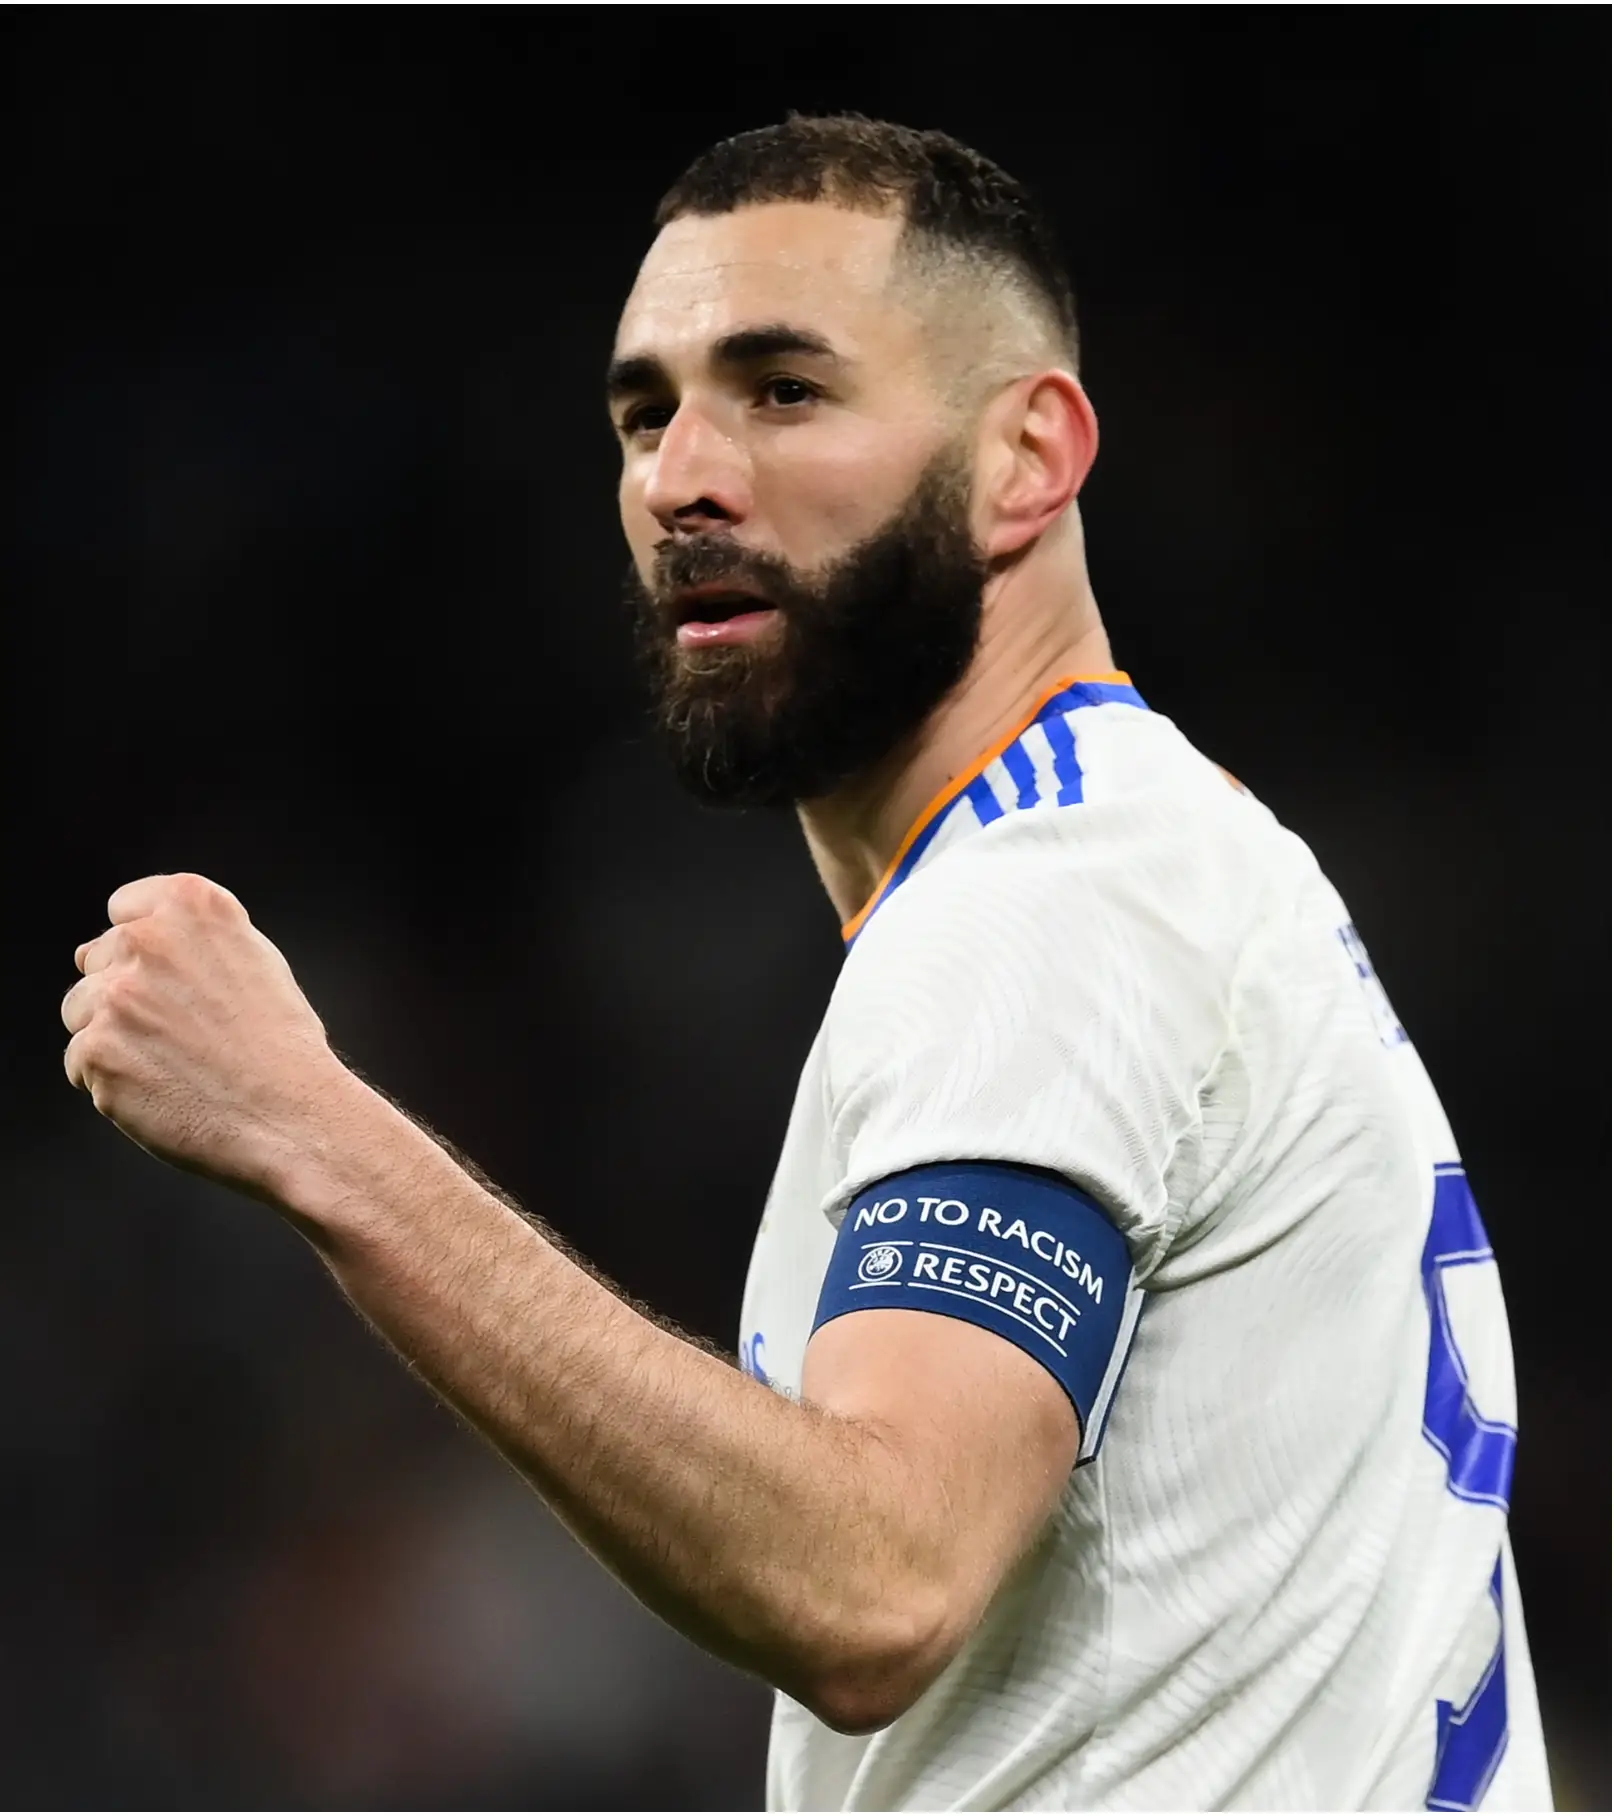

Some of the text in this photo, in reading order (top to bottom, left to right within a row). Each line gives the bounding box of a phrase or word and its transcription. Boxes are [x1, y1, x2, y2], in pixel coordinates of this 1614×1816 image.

[853, 1197, 1103, 1304] NO TO RACISM
[912, 1252, 1077, 1341] RESPECT
